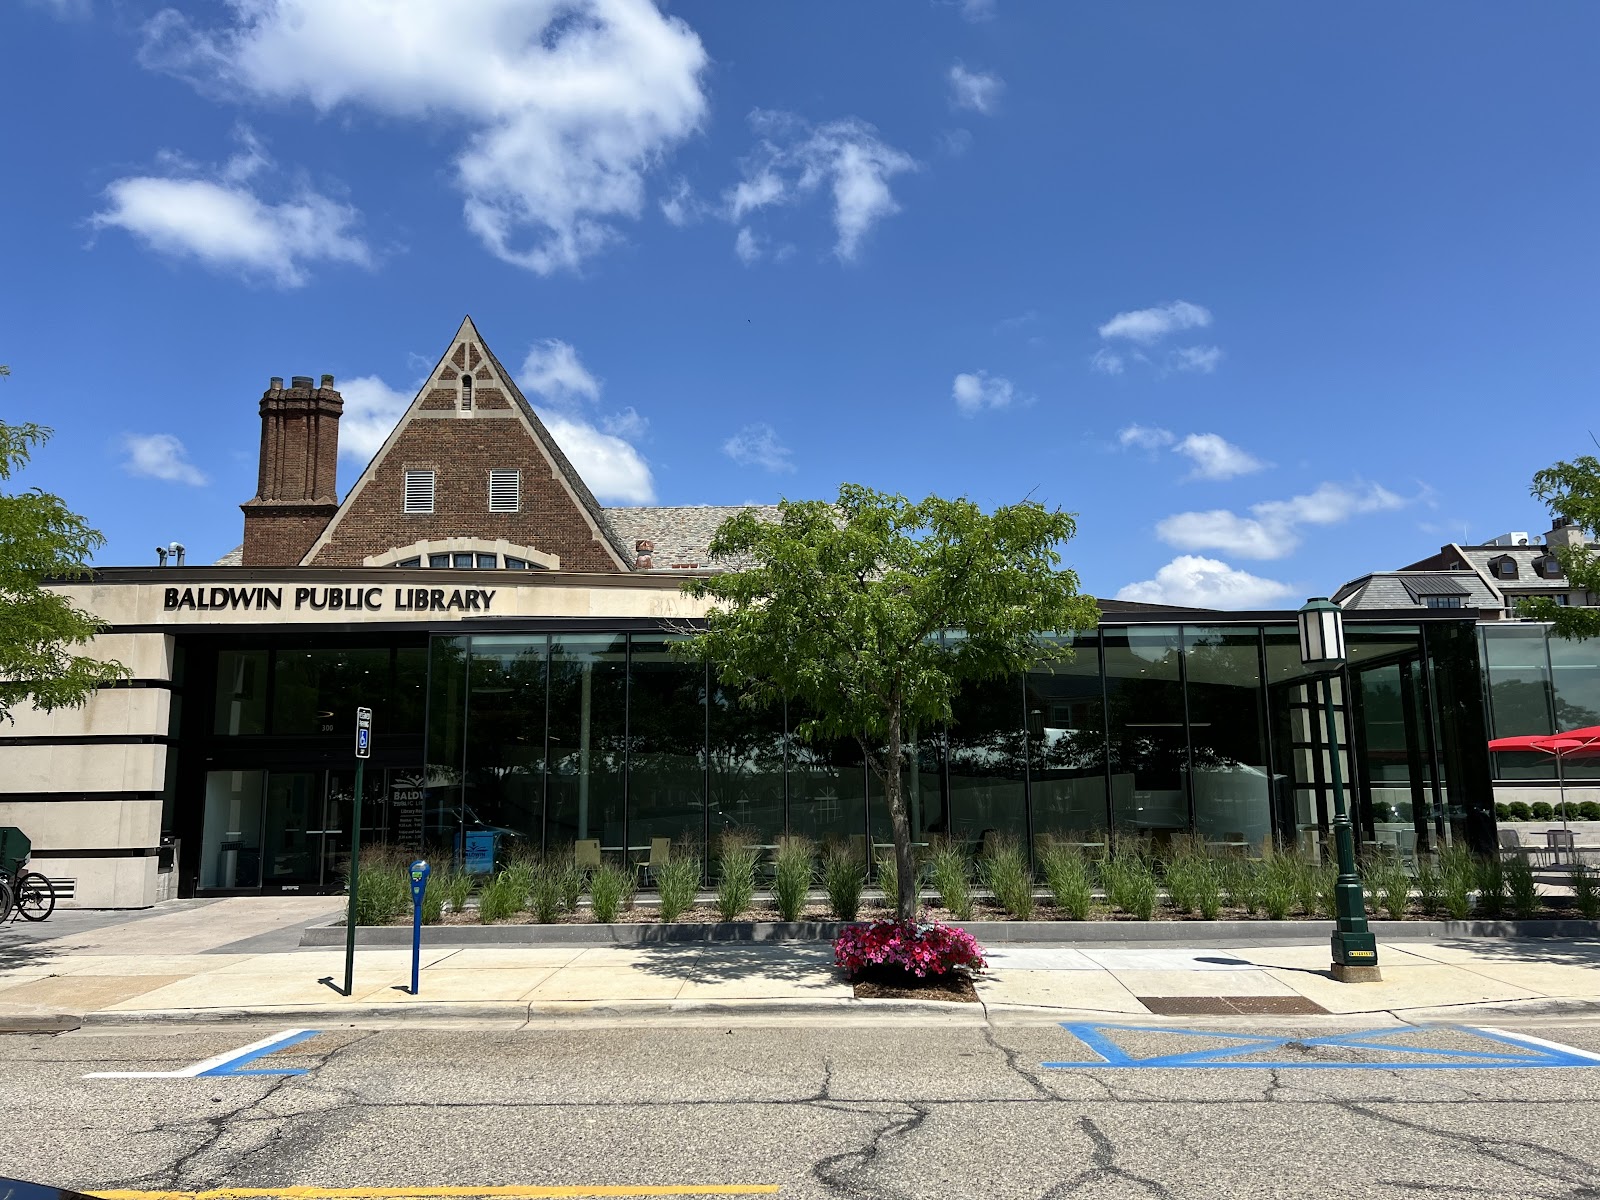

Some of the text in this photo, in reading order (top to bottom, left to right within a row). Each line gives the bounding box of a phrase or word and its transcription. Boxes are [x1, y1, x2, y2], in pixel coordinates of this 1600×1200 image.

[164, 587, 496, 611] BALDWIN PUBLIC LIBRARY
[321, 724, 334, 732] 300
